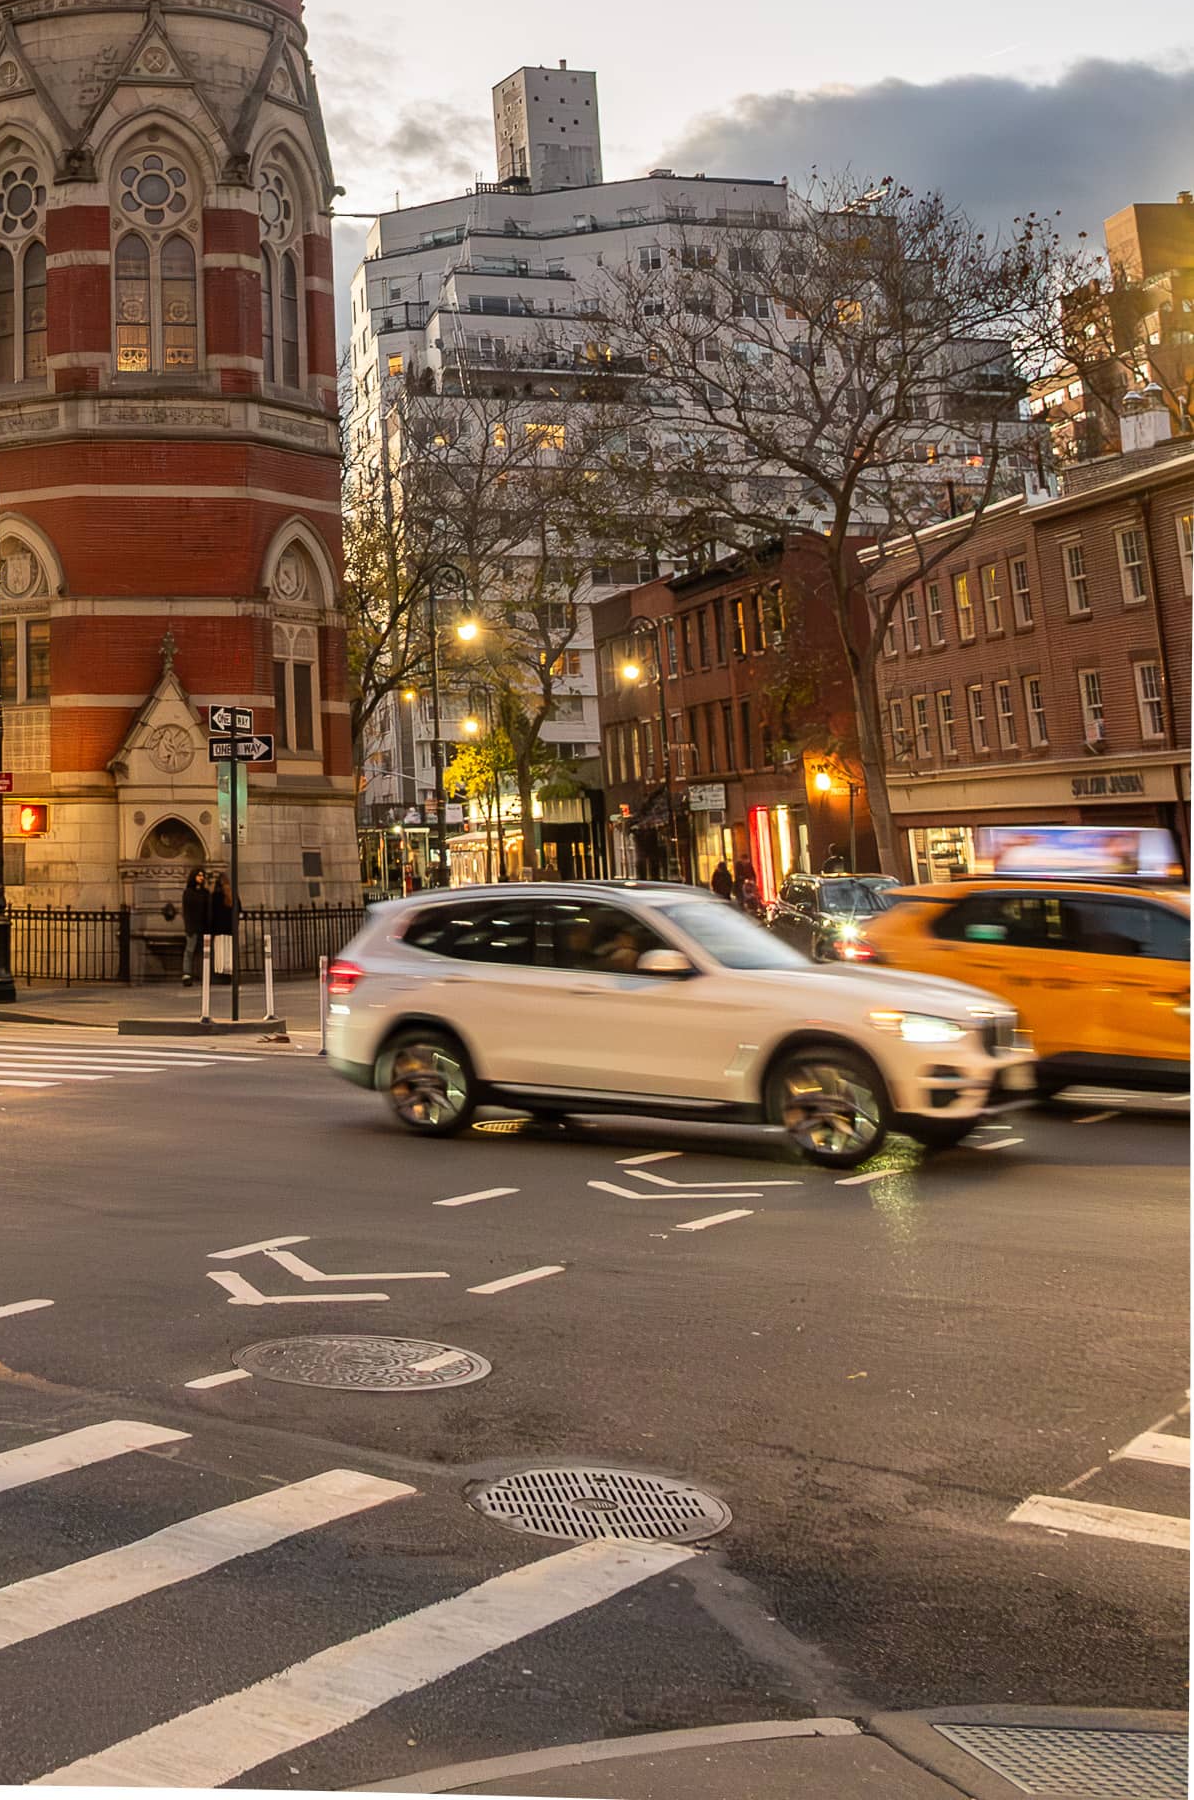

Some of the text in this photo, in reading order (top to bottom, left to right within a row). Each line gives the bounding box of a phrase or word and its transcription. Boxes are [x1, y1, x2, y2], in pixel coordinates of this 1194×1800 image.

[217, 713, 250, 727] ONE WAY
[214, 743, 262, 755] ONE WAY
